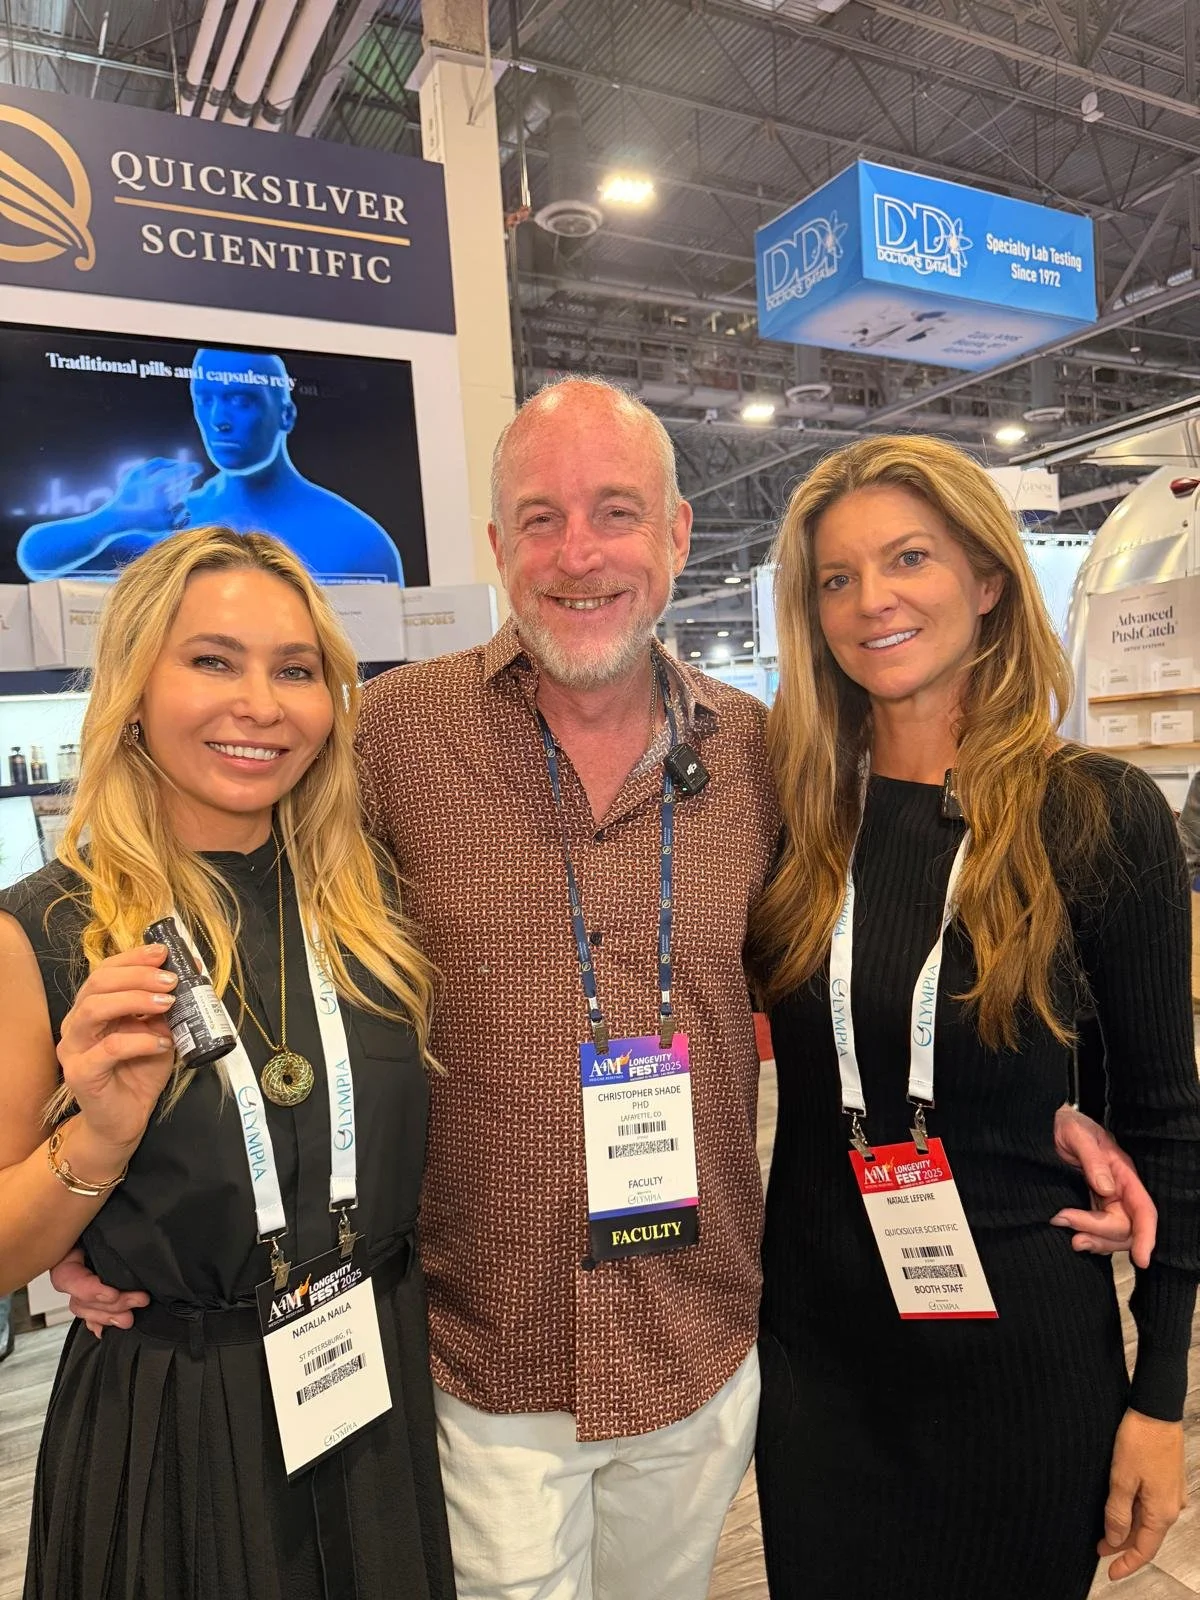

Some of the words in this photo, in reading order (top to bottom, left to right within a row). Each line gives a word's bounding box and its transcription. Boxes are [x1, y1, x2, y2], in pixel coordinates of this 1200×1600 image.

[110, 150, 408, 226] QUICKSILVER
[142, 223, 392, 284] SCIENTIFIC
[986, 233, 1030, 261] Specialty
[1032, 244, 1049, 262] Lab
[1050, 247, 1082, 272] Testing
[1011, 263, 1037, 283] Since
[1039, 268, 1061, 287] 1972
[46, 352, 137, 374] Traditional
[140, 362, 172, 379] pills
[174, 365, 204, 380] and
[206, 369, 268, 387] capsules
[269, 375, 296, 391] rely
[1116, 605, 1173, 627] Advanced
[835, 883, 852, 937] LYMPIA
[832, 978, 848, 1057] OLYMPIA
[913, 964, 938, 1047] OLYMPIA
[629, 1053, 672, 1066] LONGEVITY
[629, 1063, 658, 1078] FEST
[660, 1061, 681, 1072] 2025
[334, 1059, 354, 1151] OLYMPIA
[598, 1088, 653, 1101] CHRISTOPHER
[654, 1086, 681, 1096] SHADE
[632, 1101, 649, 1109] PHD
[621, 1112, 652, 1121] LAFAYETTE,
[238, 1086, 268, 1181] OLYMPIA
[894, 1160, 931, 1174] LONGEVITY
[896, 1171, 922, 1185] FEST
[922, 1168, 943, 1180] 2025
[628, 1176, 663, 1189] FACULTY
[887, 1196, 910, 1205] NATALIE
[910, 1193, 935, 1203] LEFEVRE
[612, 1221, 682, 1246] FACULTY
[885, 1226, 923, 1237] QUICKSILVER
[924, 1224, 959, 1234] SCIENTIFIC
[309, 1263, 352, 1294] LONGEVITY
[309, 1280, 339, 1306] FEST
[340, 1268, 362, 1288] 2025
[914, 1285, 940, 1294] BOOTH
[941, 1284, 964, 1293] STAFF
[292, 1315, 326, 1339] NATALIA
[327, 1302, 351, 1319] NAILA
[299, 1352, 306, 1362] ST
[308, 1333, 345, 1357] PETERSBURG,
